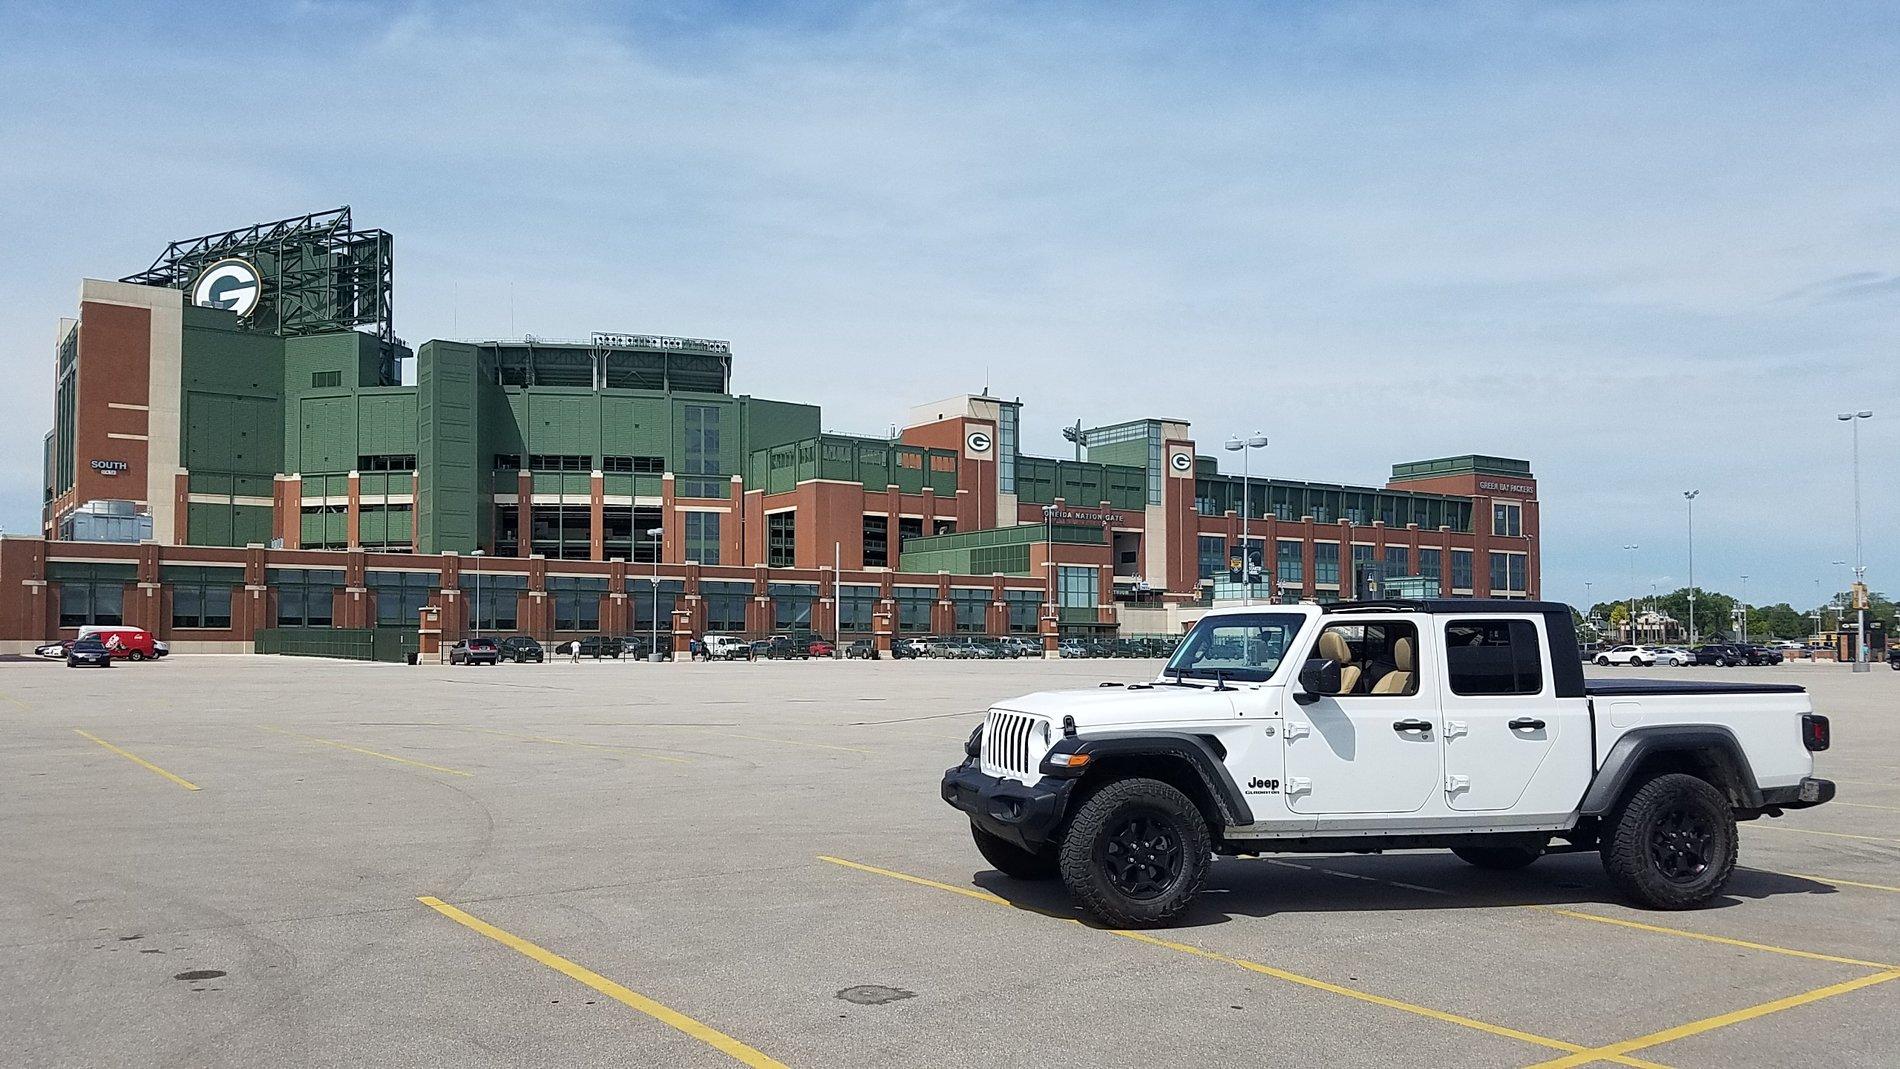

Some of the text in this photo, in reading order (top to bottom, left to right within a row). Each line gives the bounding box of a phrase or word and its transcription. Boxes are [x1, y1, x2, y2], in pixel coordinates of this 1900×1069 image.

[968, 433, 991, 451] G
[91, 460, 127, 470] SOUTH
[1172, 453, 1191, 470] G
[1480, 481, 1499, 490] GREEN
[1044, 510, 1124, 522] ONEIDA NATION GATE
[1248, 776, 1279, 790] Jeep
